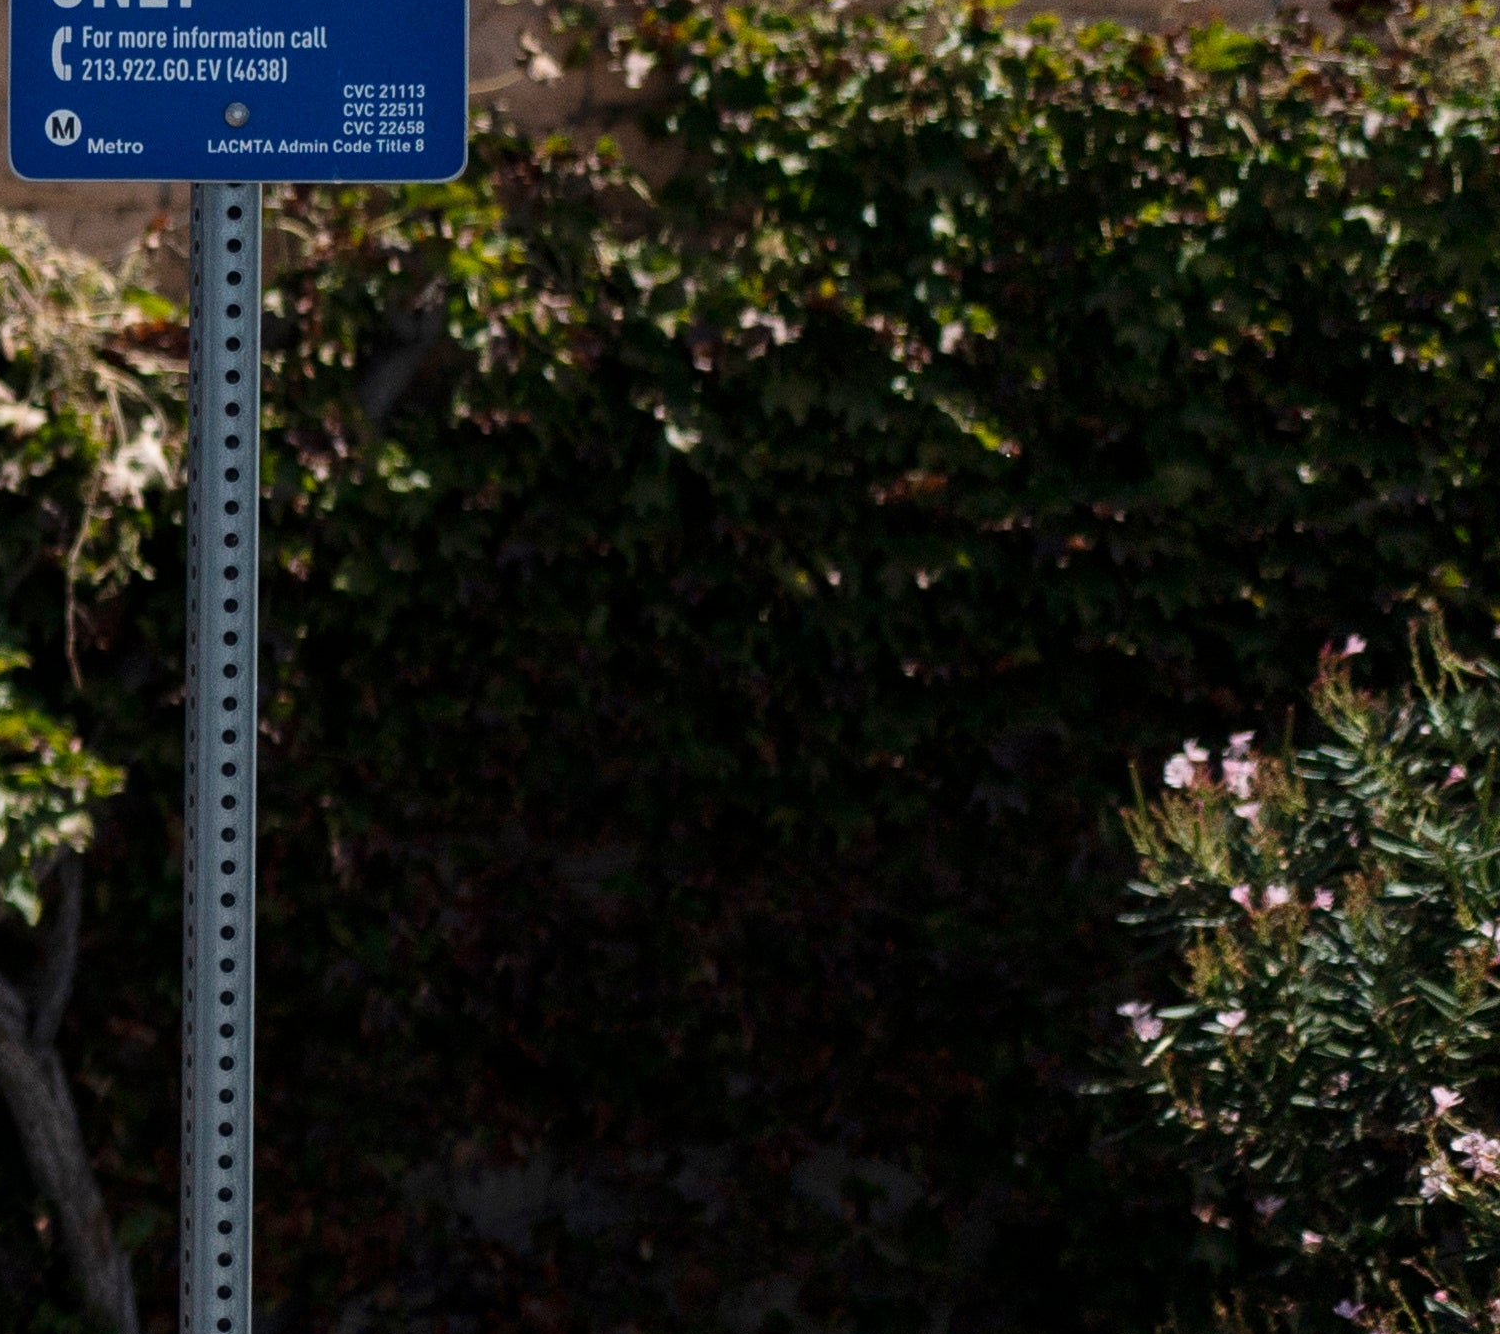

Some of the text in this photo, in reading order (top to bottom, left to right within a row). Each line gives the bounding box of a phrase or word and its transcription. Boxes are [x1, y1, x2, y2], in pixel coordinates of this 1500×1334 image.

[82, 26, 327, 49] For more information call
[82, 57, 287, 83] 213.922.GO.EV (4638)
[343, 84, 425, 99] CVC 21113
[343, 103, 424, 117] CVC 22511
[343, 121, 425, 135] CVC 22658
[88, 138, 144, 154] Metro
[208, 138, 424, 153] LACMTA Admin Code Title 8
